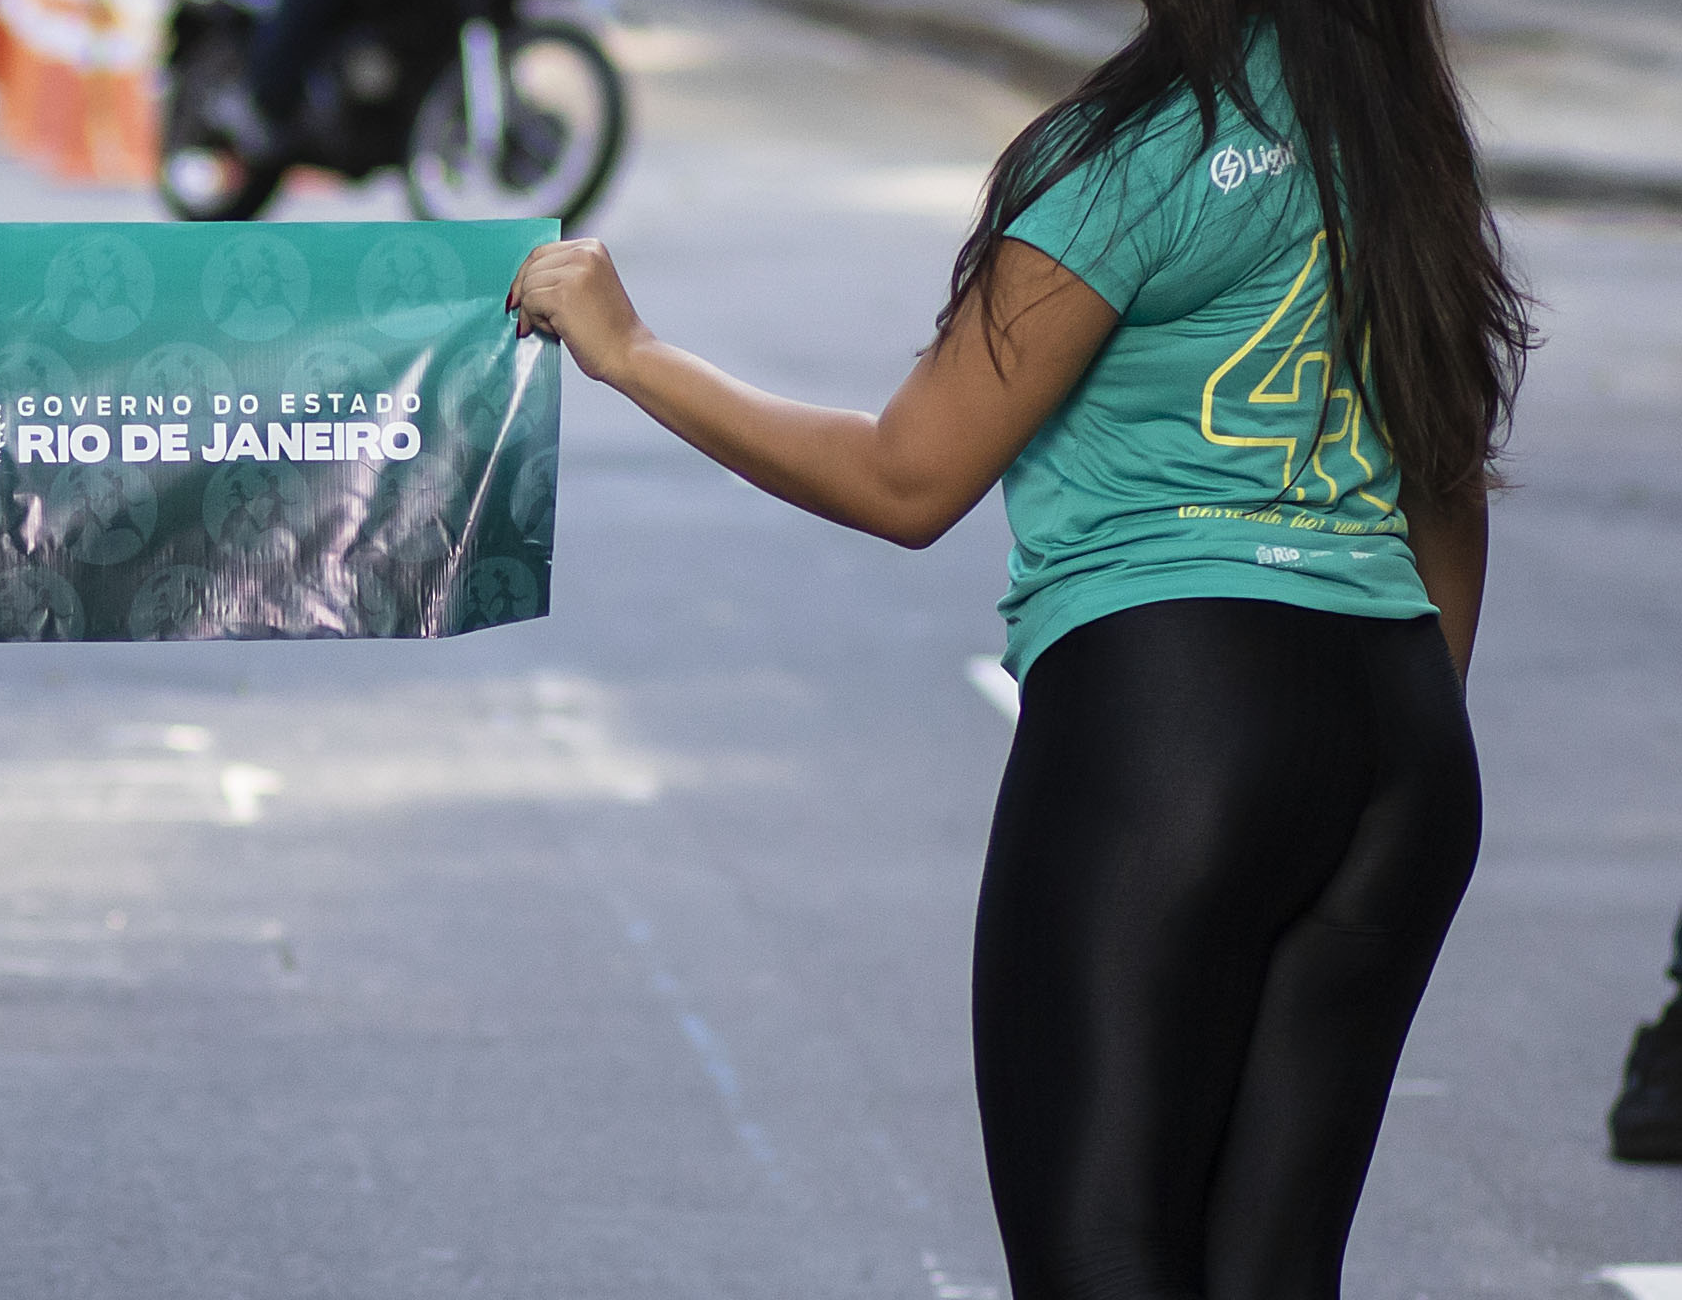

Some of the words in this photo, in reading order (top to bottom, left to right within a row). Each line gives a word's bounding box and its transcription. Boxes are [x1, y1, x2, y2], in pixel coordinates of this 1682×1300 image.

[18, 395, 192, 416] GOVERNO
[214, 394, 259, 416] DO
[281, 392, 421, 414] ESTADO
[18, 424, 111, 464] RIO
[121, 423, 190, 463] DE
[202, 421, 422, 463] JANEIRO
